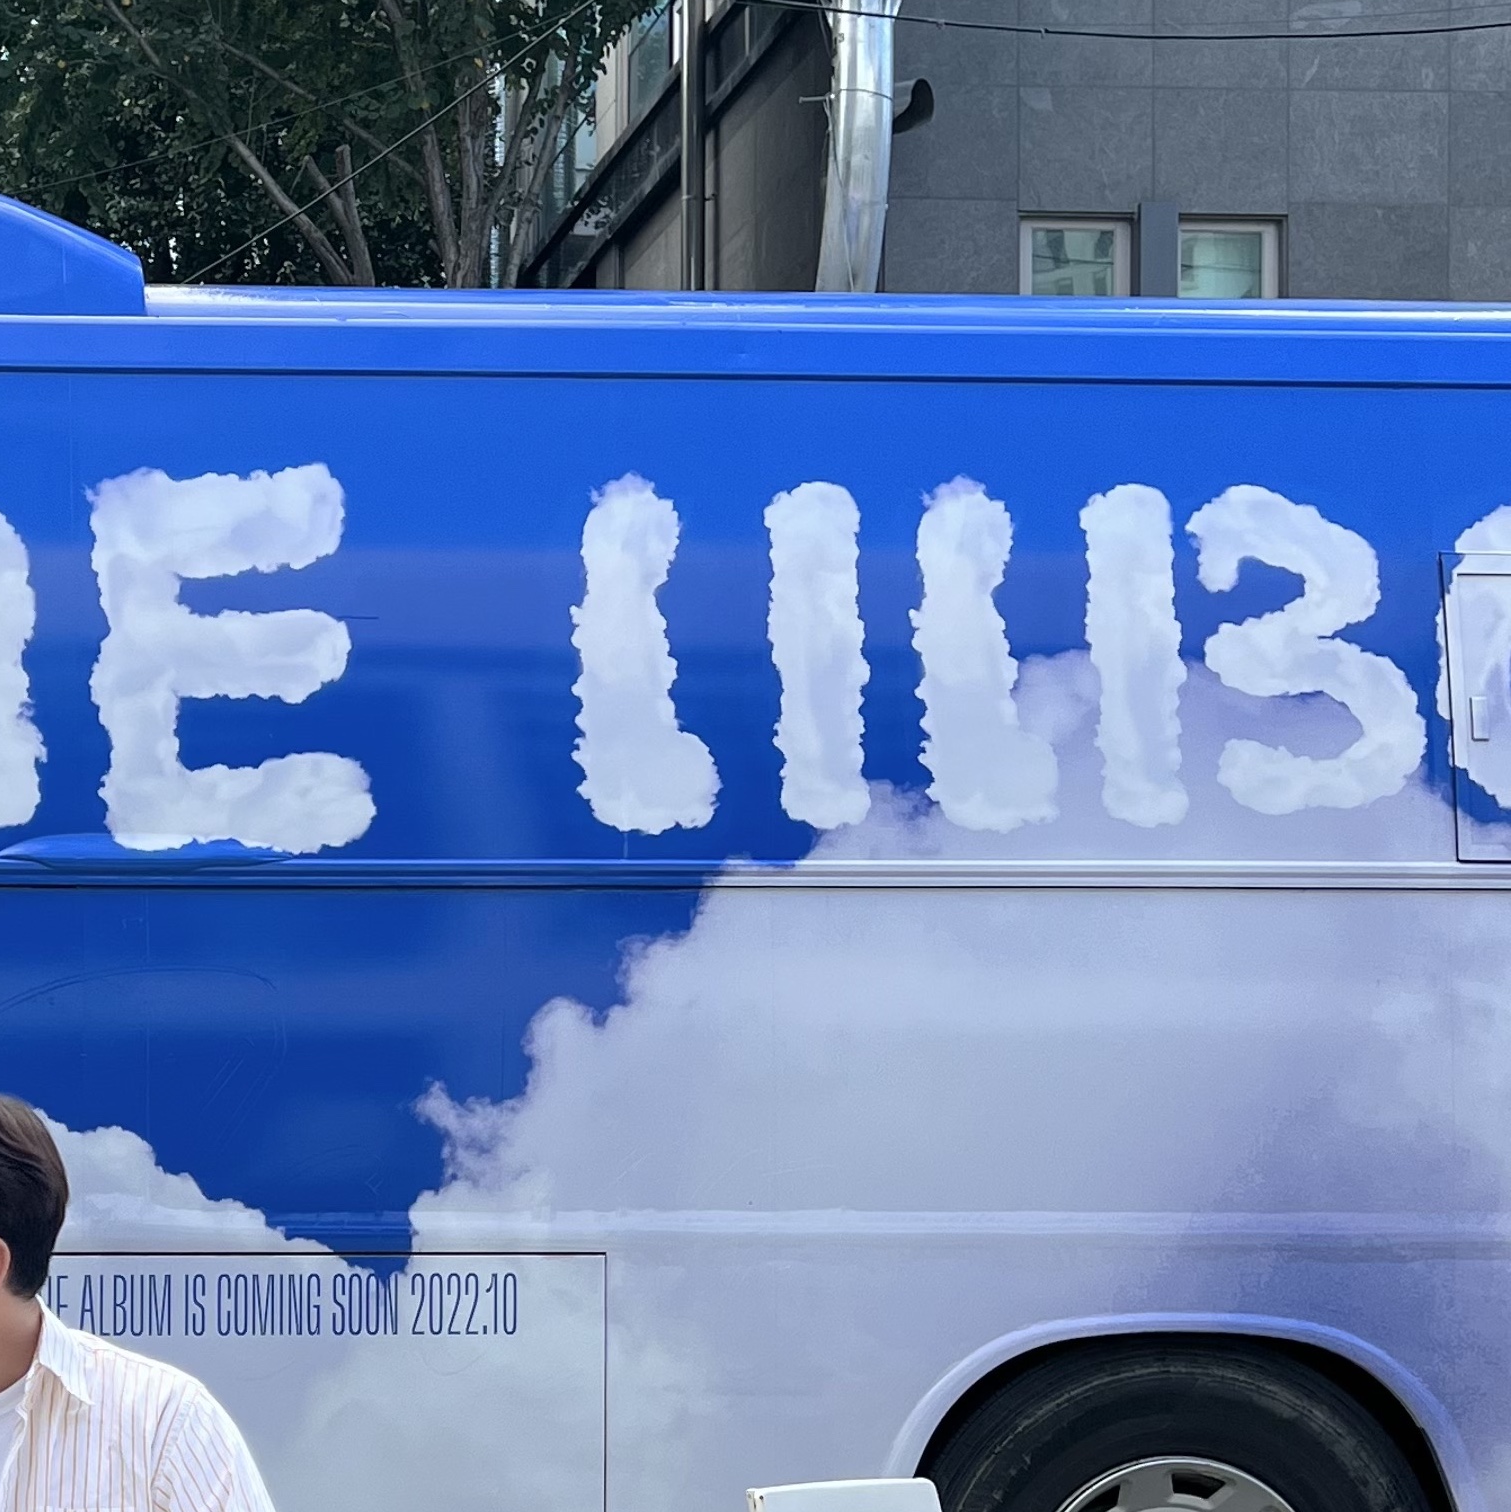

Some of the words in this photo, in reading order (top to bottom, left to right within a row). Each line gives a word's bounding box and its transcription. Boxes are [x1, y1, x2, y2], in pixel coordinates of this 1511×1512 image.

[79, 1274, 172, 1337] ALBUM
[185, 1273, 207, 1337] IS
[216, 1273, 322, 1337] COMING
[332, 1273, 399, 1336] SOON
[410, 1272, 519, 1336] 2022.10
